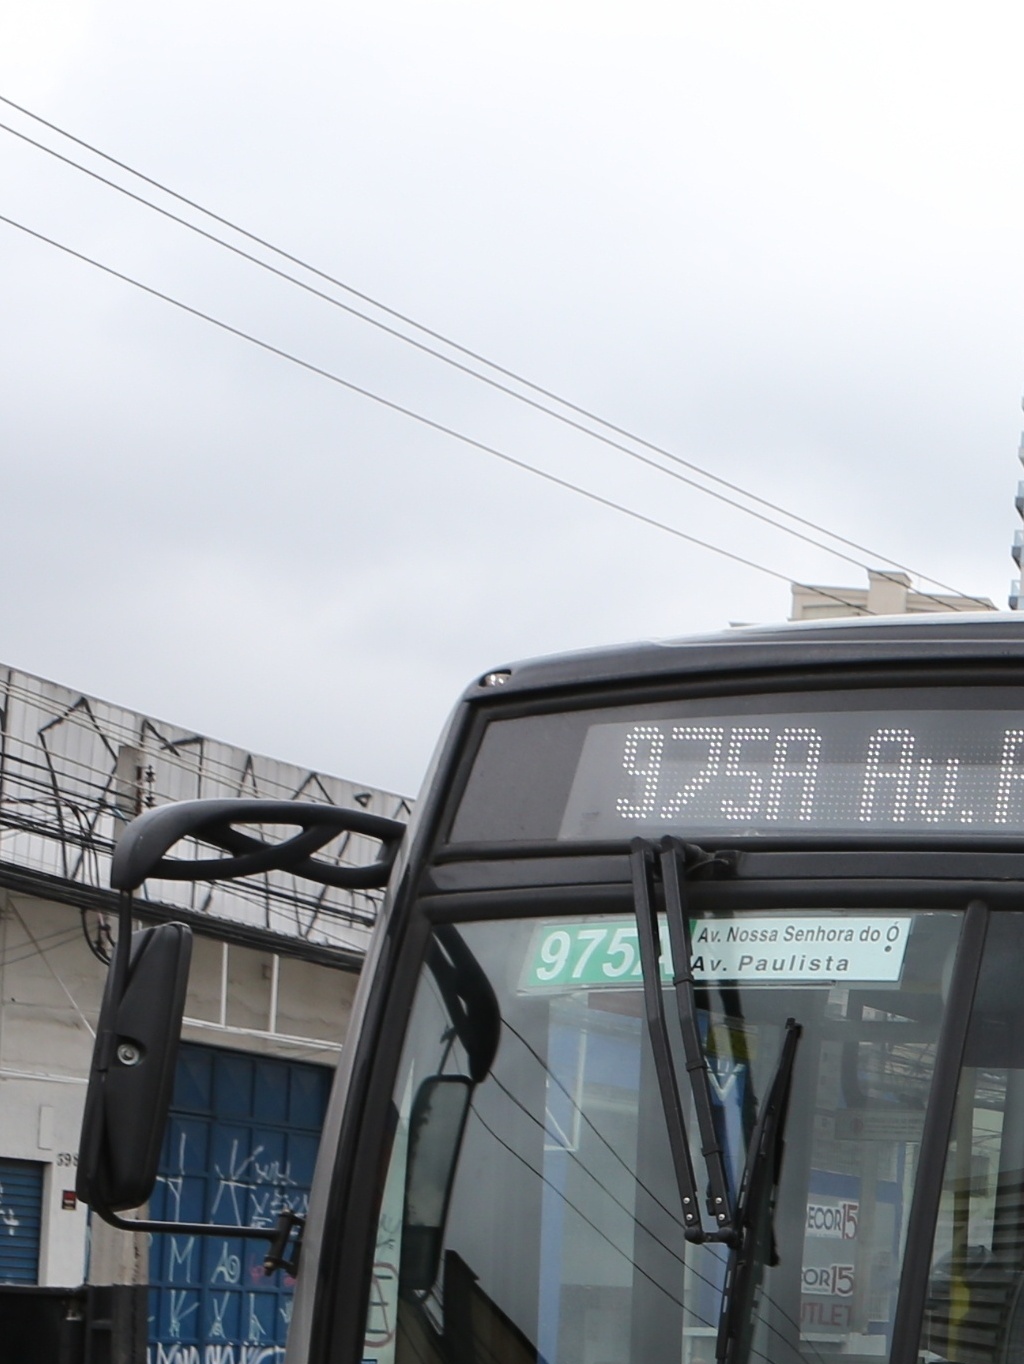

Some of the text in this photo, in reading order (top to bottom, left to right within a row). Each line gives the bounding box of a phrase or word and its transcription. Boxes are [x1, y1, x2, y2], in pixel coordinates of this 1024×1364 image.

[616, 726, 822, 820] 975A
[860, 728, 974, 823] Av.
[697, 921, 900, 943] Av. Nossa Senhora do Ó
[690, 955, 850, 972] Av. Paulista
